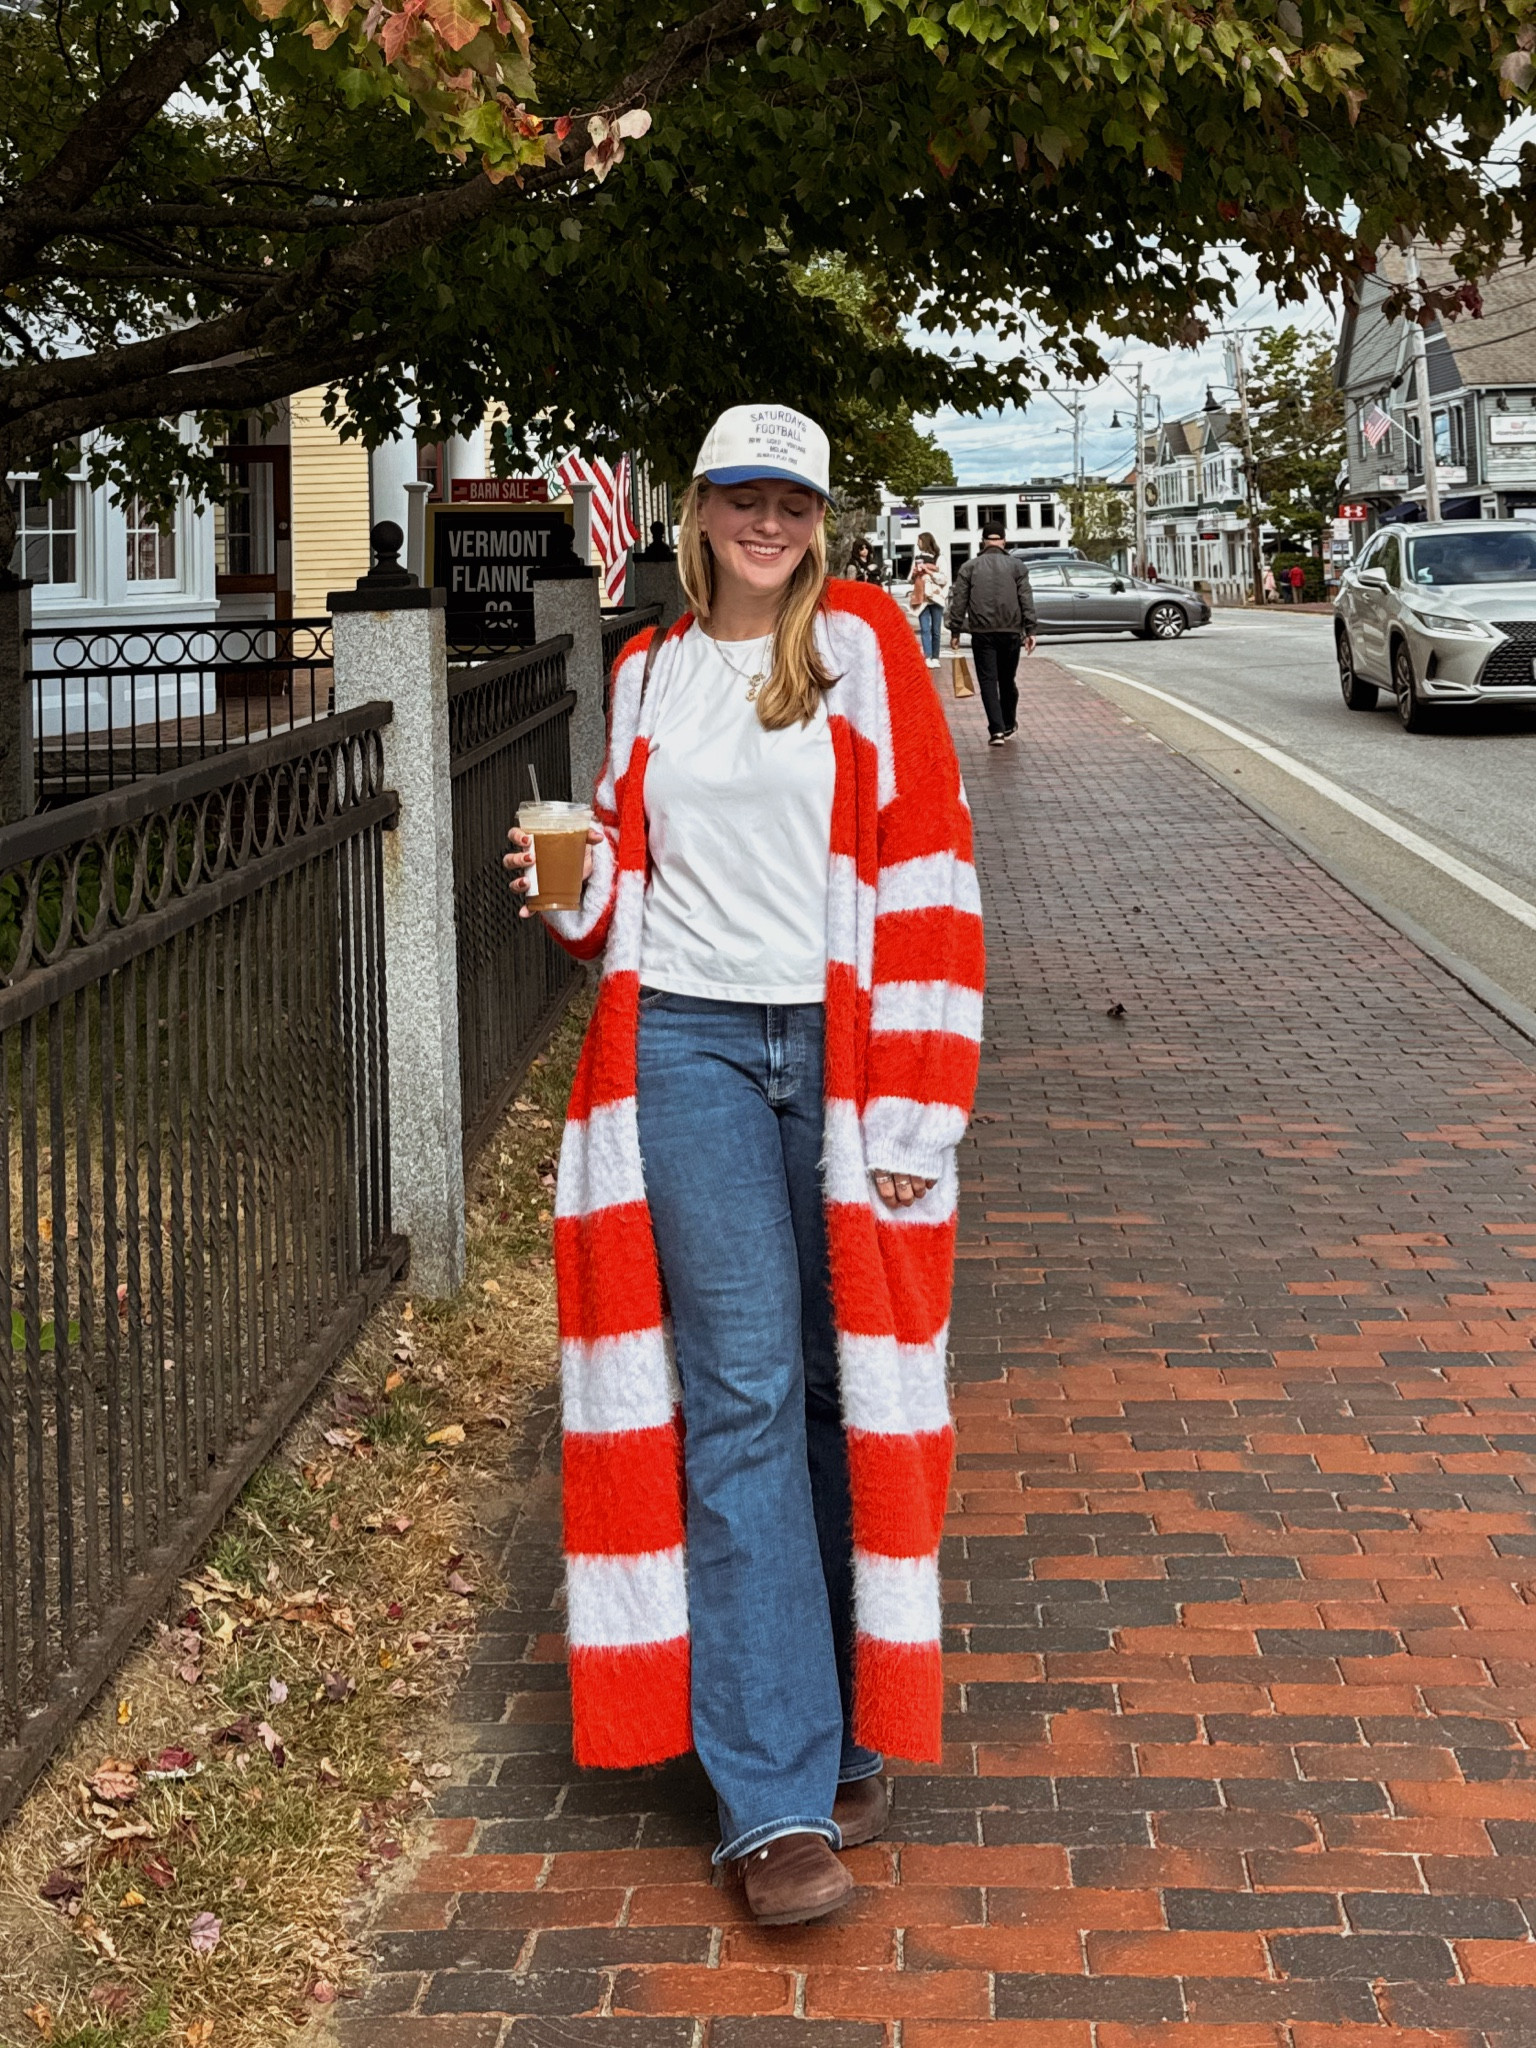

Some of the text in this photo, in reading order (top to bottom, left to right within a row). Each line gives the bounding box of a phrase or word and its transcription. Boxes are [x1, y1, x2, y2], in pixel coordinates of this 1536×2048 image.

[750, 410, 807, 433] SATURDAYS
[756, 424, 801, 442] FOOTBALL
[470, 482, 529, 499] BARN SALE
[448, 530, 551, 557] VERMONT
[452, 565, 540, 592] FLANNE
